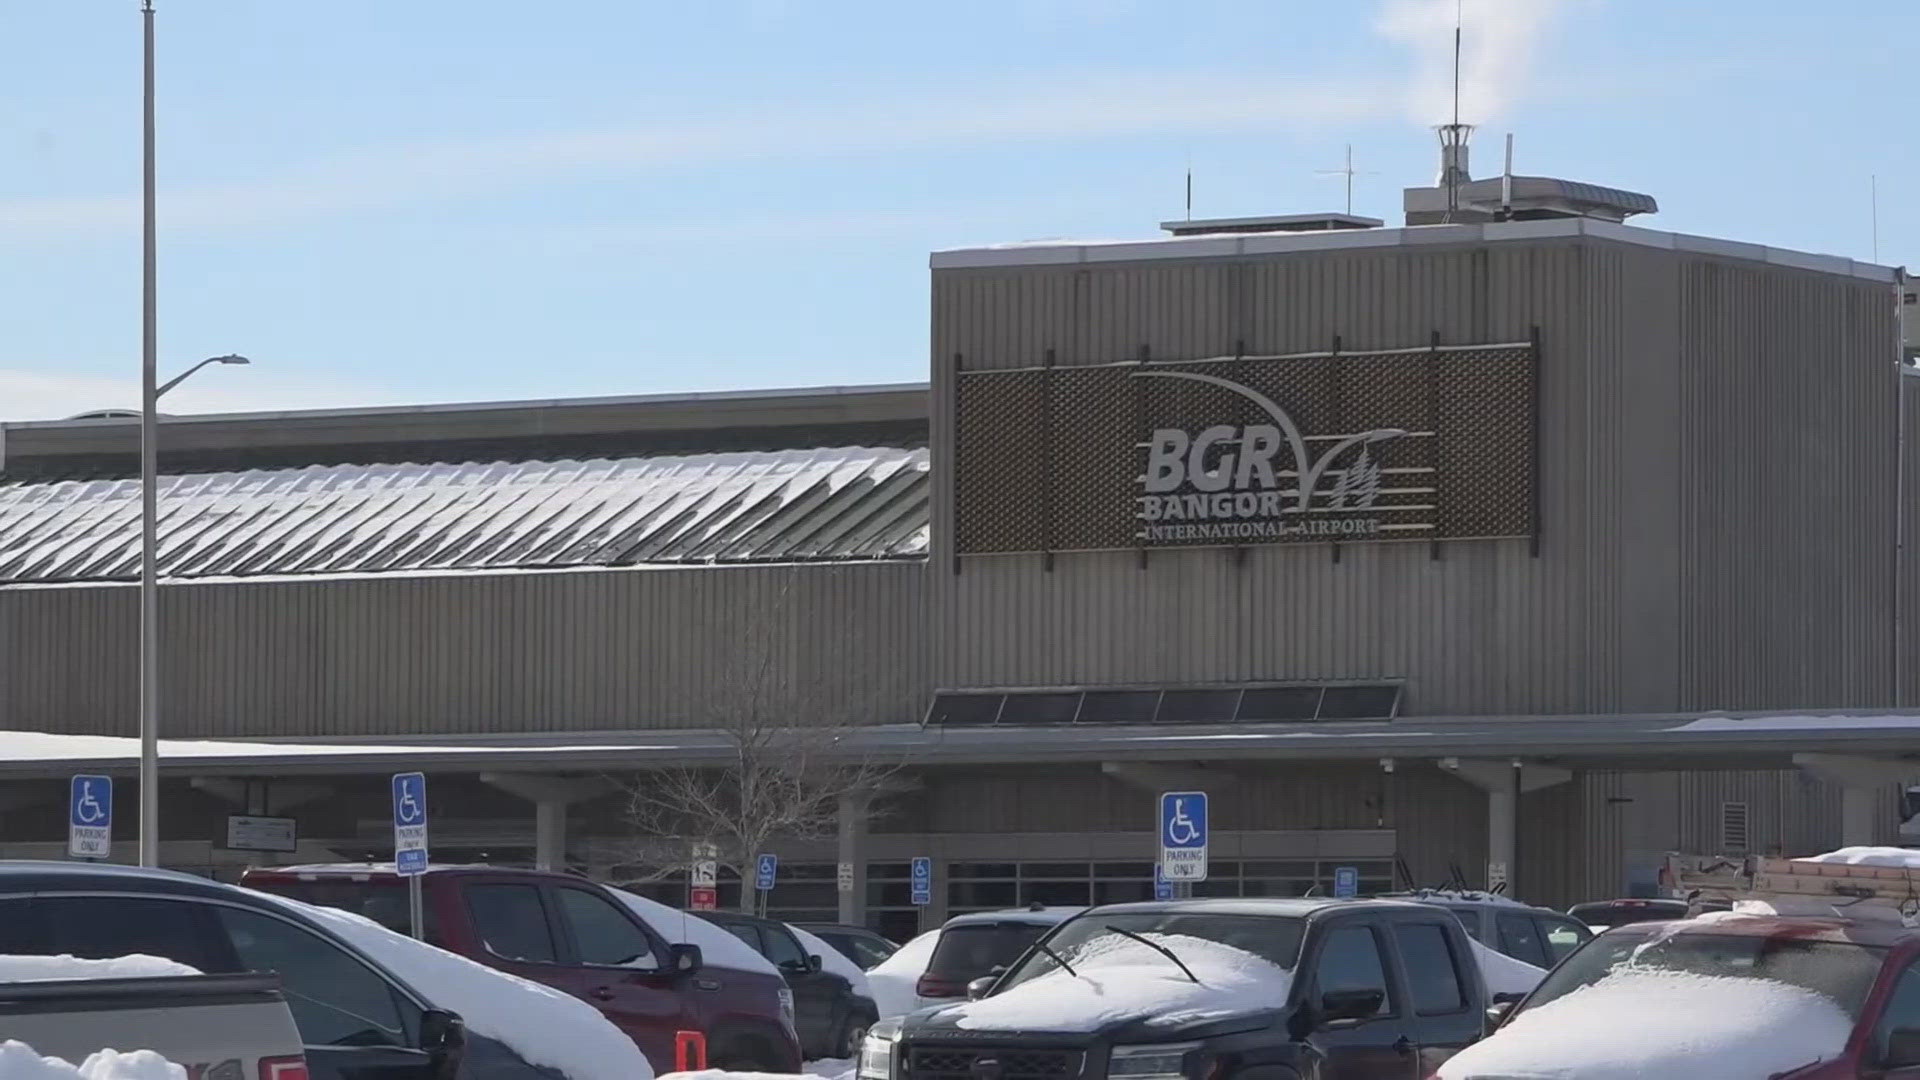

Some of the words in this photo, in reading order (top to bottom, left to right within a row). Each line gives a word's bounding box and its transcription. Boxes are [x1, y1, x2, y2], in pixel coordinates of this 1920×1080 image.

[1145, 424, 1281, 492] BGR
[1144, 492, 1280, 520] BANGOR
[1144, 521, 1287, 540] INTERNATIONAL
[1298, 518, 1378, 534] AIRPORT
[74, 828, 107, 839] PARKING
[1166, 850, 1203, 861] PARKING
[1173, 863, 1196, 876] ONLY
